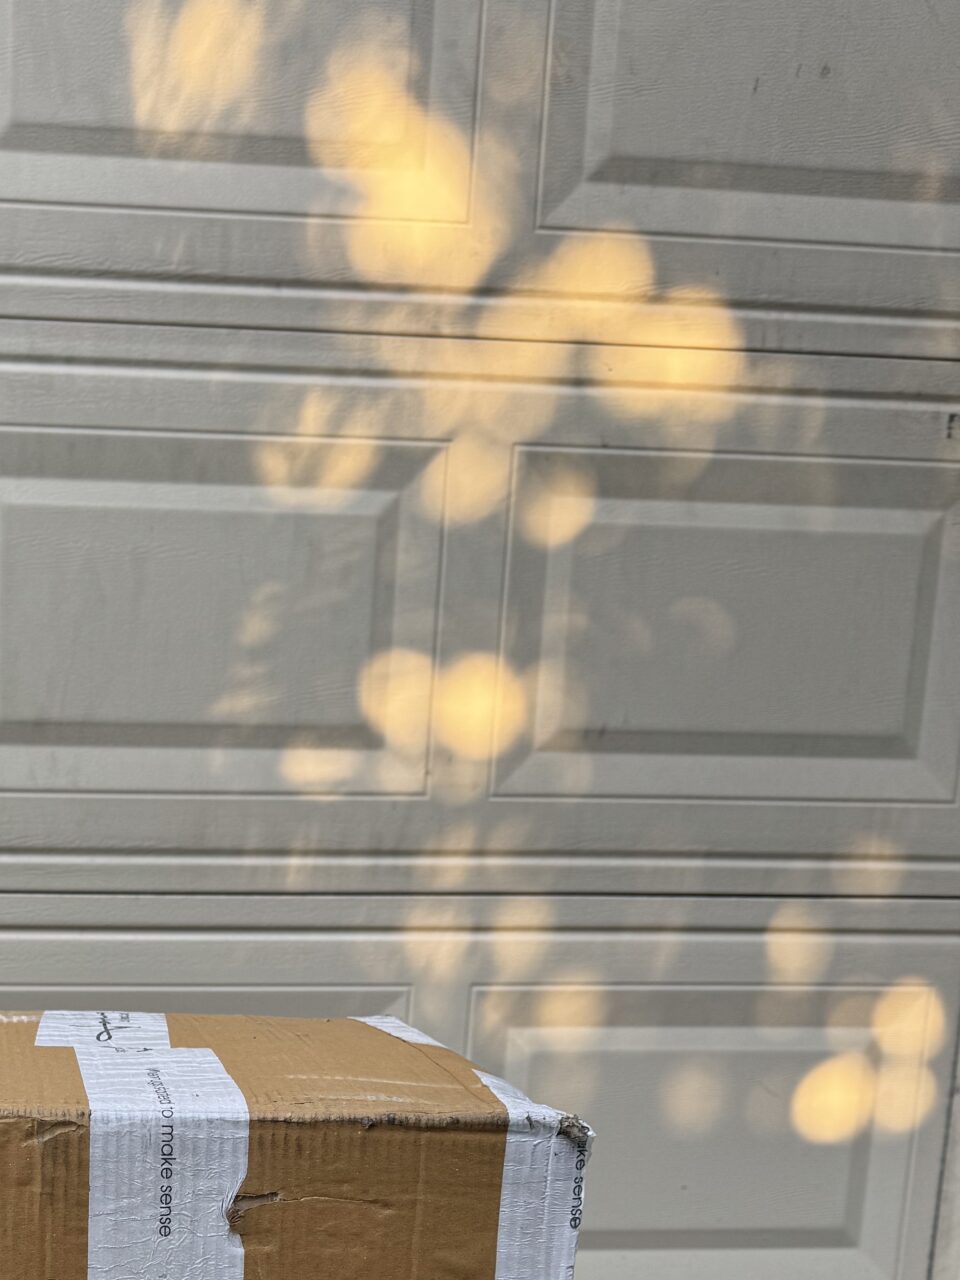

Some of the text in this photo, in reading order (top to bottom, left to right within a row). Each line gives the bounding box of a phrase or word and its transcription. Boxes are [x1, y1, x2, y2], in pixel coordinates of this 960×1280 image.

[160, 1124, 177, 1180] make
[159, 1184, 173, 1238] sense
[569, 1176, 584, 1230] sense
